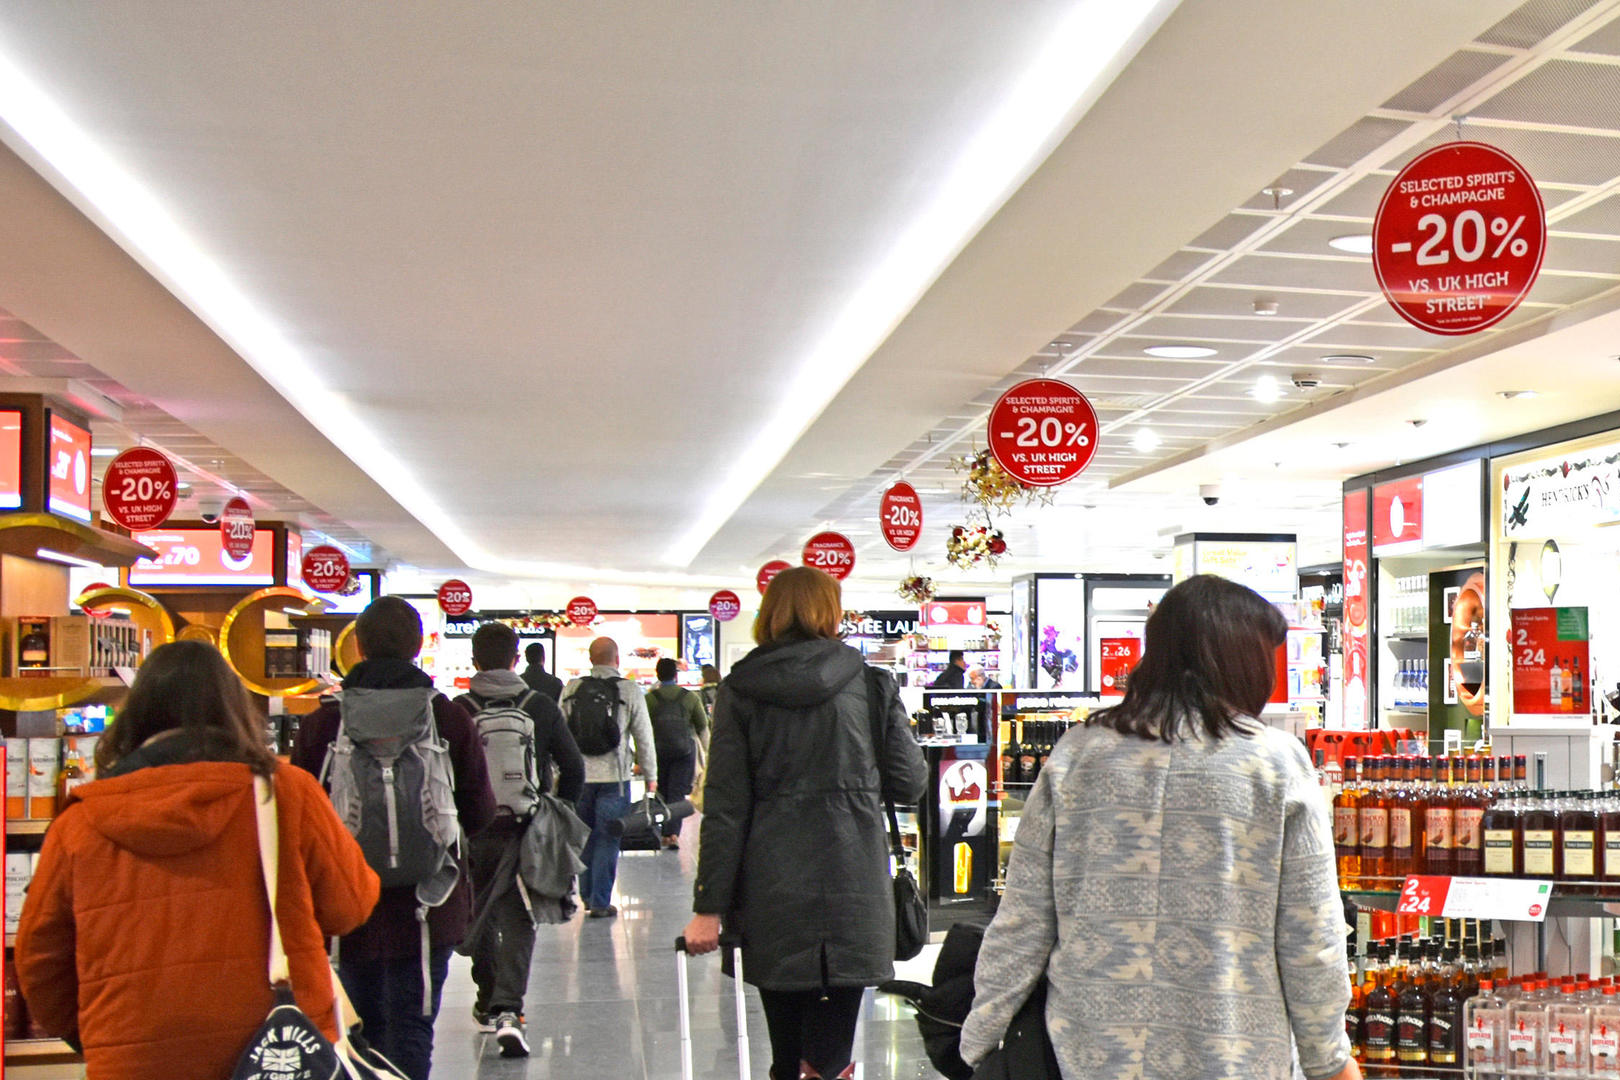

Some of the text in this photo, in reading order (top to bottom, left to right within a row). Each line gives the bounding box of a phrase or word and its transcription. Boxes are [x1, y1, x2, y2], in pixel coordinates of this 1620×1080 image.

[1400, 171, 1516, 194] SELECTED SPIRITS
[1410, 188, 1505, 208] & CHAMPAGNE
[1392, 209, 1528, 266] -20%
[1409, 271, 1509, 293] VS. UK HIGH
[1006, 397, 1080, 405] SELECTED SPIRITS
[1020, 405, 1074, 413] CHAMPAGNE
[1000, 417, 1089, 447] -20%
[1031, 453, 1077, 462] UK HIGH
[111, 476, 171, 501] -20%
[884, 505, 919, 527] -20%
[226, 520, 252, 540] -20%
[807, 550, 850, 565] -20%
[305, 561, 345, 577] -20%
[569, 606, 595, 616] -20%
[711, 600, 738, 611] -20%
[1517, 629, 1528, 645] 2
[1102, 646, 1109, 656] 2
[1517, 648, 1546, 665] £24
[1404, 879, 1419, 896] 2
[1400, 896, 1430, 913] £24
[249, 1025, 321, 1064] JACK WILLS
